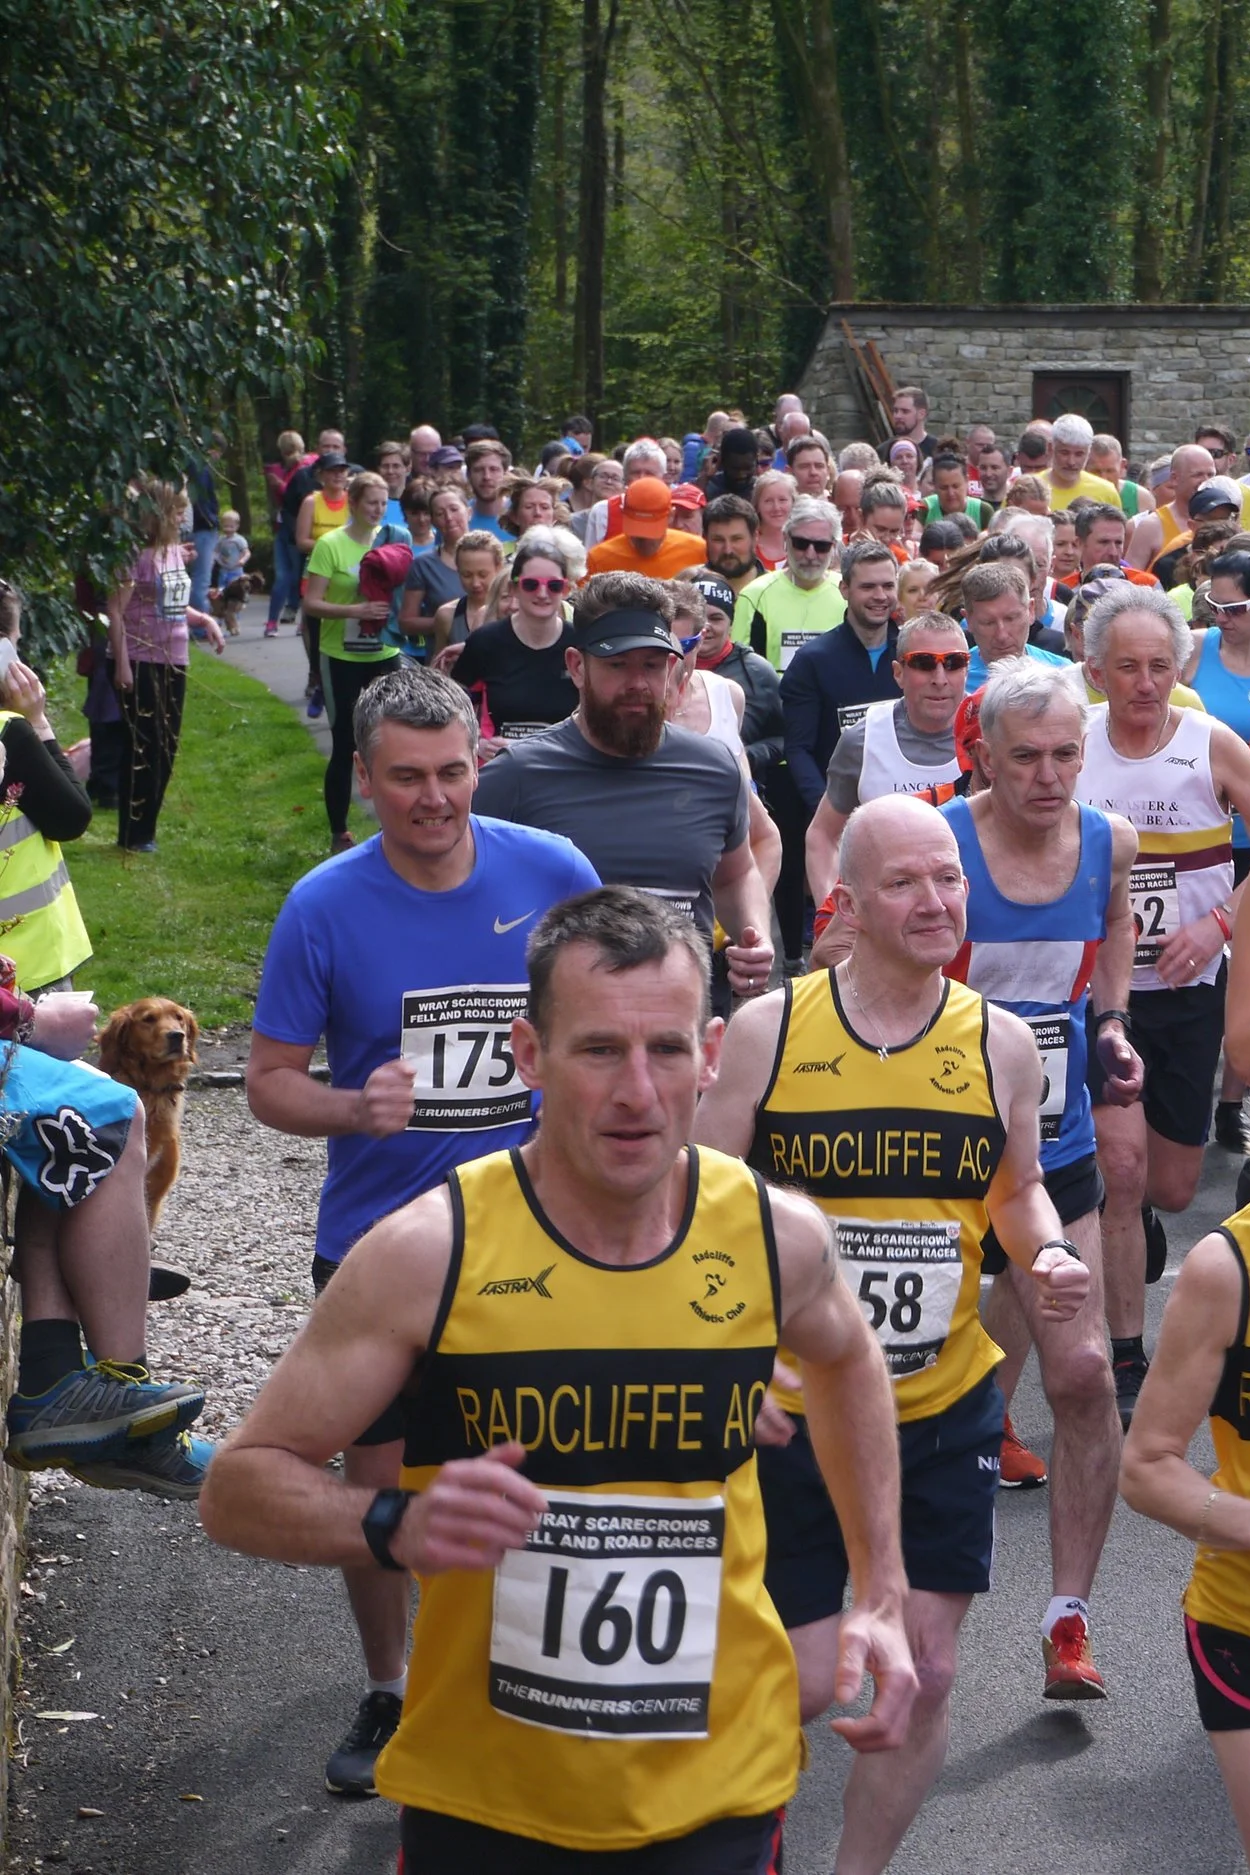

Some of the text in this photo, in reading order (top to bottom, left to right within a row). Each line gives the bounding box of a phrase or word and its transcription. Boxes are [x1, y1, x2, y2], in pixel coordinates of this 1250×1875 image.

[696, 581, 733, 604] Tish!
[1169, 801, 1179, 812] &
[1147, 880, 1173, 888] RACES
[418, 997, 528, 1012] WRAY SCARECROWS
[410, 1013, 437, 1024] FELL
[439, 1010, 461, 1020] AND
[464, 1008, 495, 1019] ROAD
[432, 1031, 517, 1089] 175
[414, 1100, 528, 1117] HERUNNERSCENTRE
[770, 1130, 992, 1182] RADCLIFFE AC
[873, 1233, 951, 1246] SCARECROWS
[692, 1250, 735, 1268] Radcliffe
[857, 1246, 883, 1257] AND
[886, 1246, 920, 1258] ROAD
[922, 1247, 957, 1258] RACES
[858, 1270, 923, 1333] 58
[689, 1300, 746, 1323] Athletic Club
[457, 1384, 704, 1453] RADCLIFFE
[584, 1516, 711, 1533] SCARECROWS
[526, 1530, 719, 1550] ELL AND ROAD RACES
[541, 1565, 687, 1666] 160
[496, 1678, 702, 1715] THERUNNERSCENTRE
